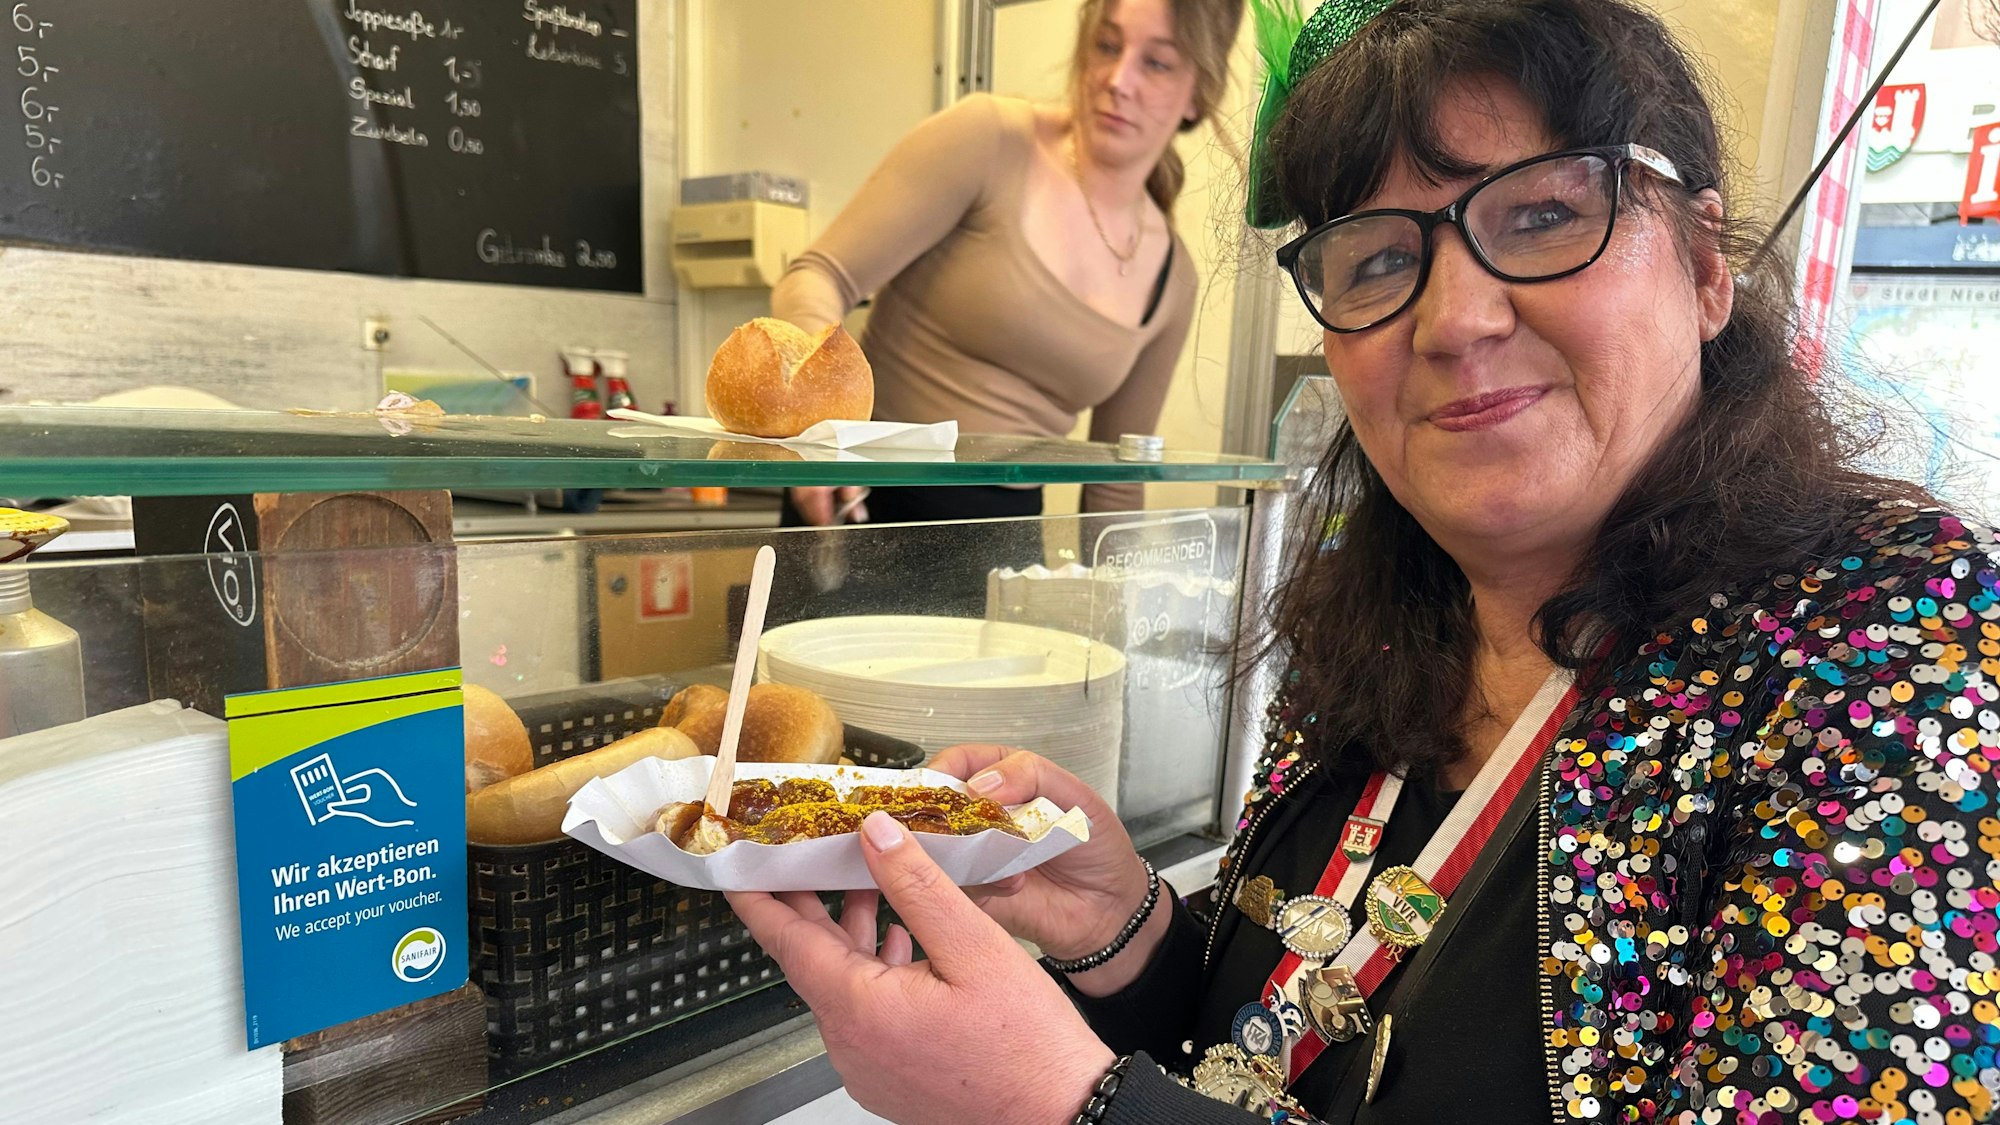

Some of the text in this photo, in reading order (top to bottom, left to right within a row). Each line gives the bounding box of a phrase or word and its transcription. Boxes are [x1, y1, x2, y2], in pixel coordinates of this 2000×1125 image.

[1106, 541, 1205, 571] RECOMMENDED
[271, 838, 439, 888] Wir akzeptieren
[273, 865, 437, 915] Ihren Wert-Bon.
[1392, 896, 1417, 923] VVR
[275, 890, 443, 941] We accept your voucher.
[401, 946, 437, 964] SANIFAIR
